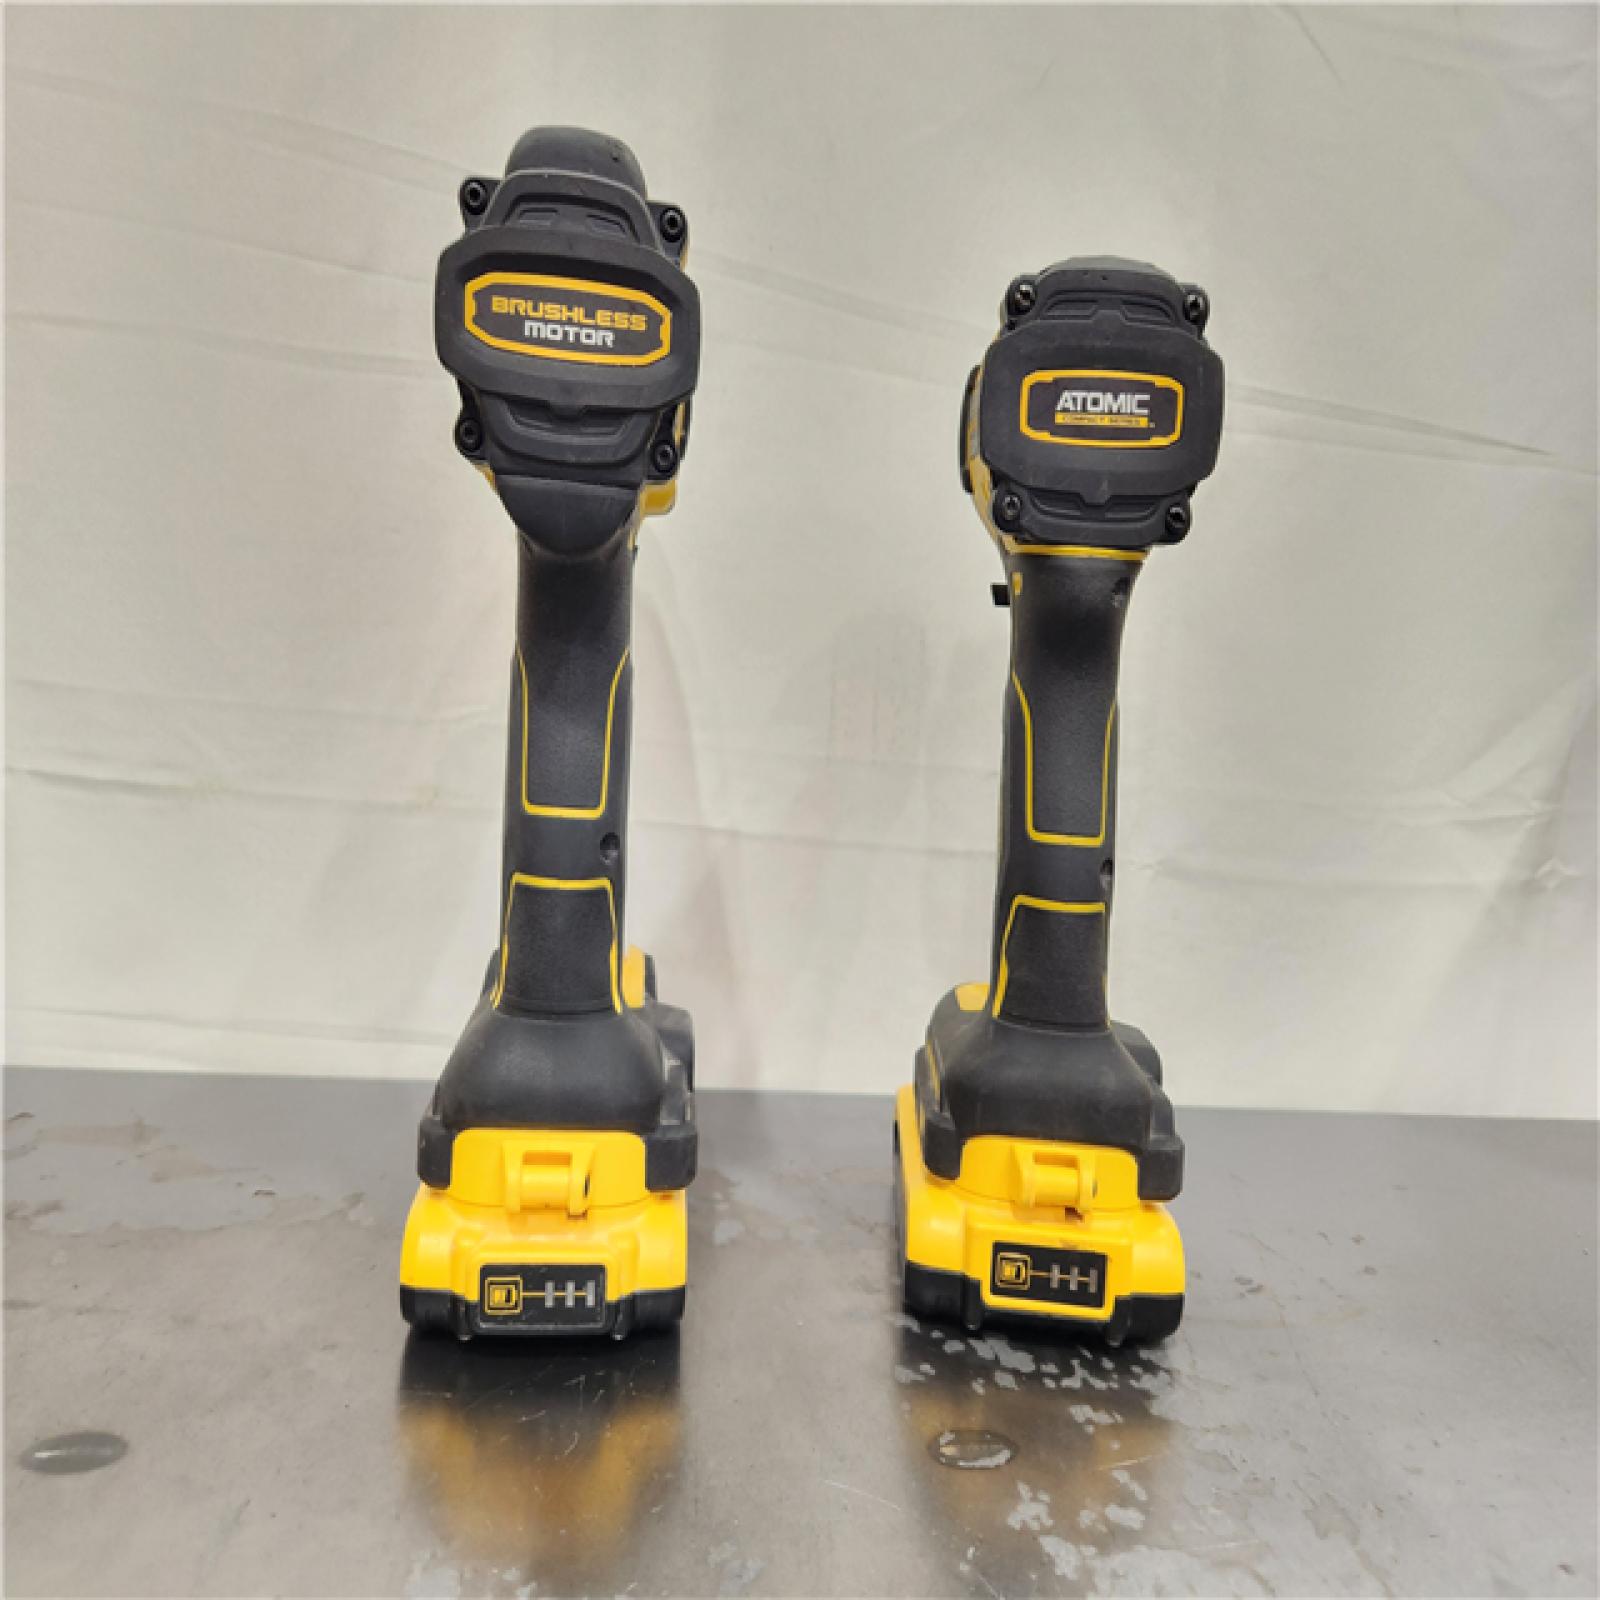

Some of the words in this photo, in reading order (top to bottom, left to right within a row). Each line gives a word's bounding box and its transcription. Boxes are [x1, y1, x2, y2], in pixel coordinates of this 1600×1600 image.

[491, 295, 648, 331] BRUSHLESS
[524, 319, 616, 348] MOTOR
[1055, 390, 1150, 415] ATOMIC
